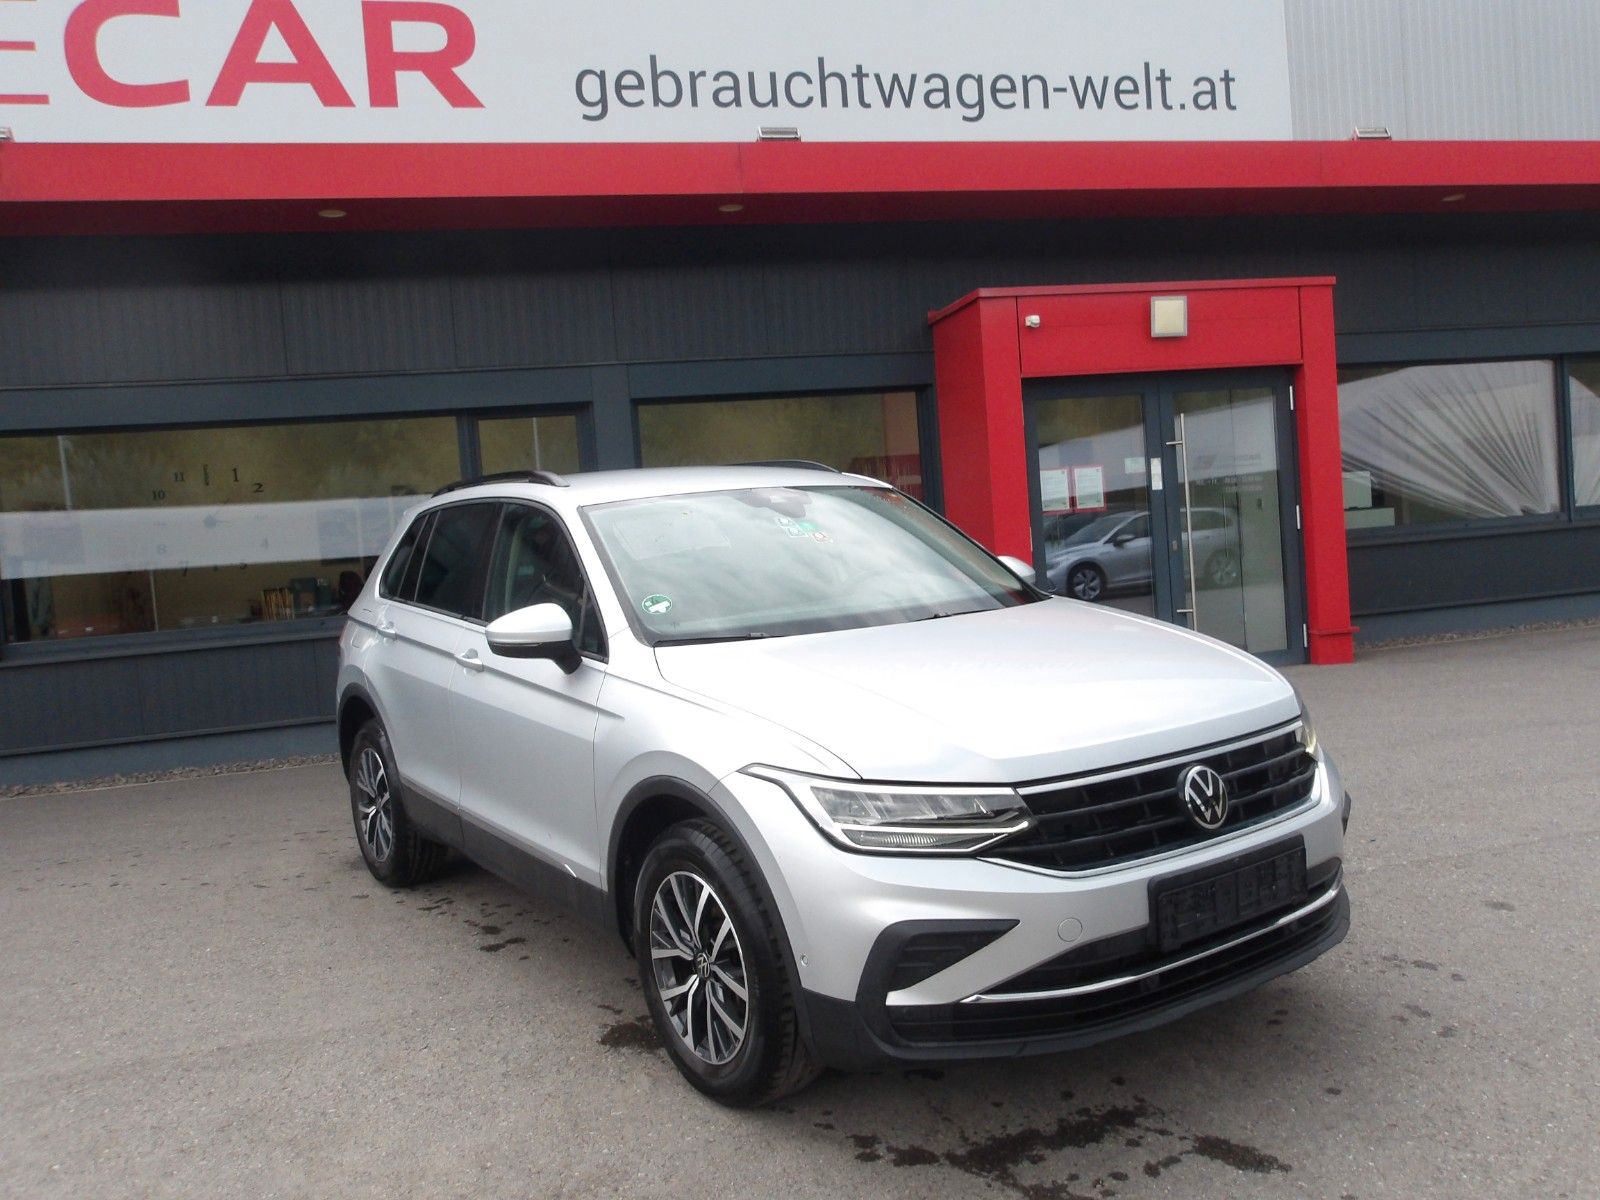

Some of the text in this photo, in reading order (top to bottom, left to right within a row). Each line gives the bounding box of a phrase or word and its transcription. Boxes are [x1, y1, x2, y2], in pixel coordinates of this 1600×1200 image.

[574, 54, 1237, 122] gebrauchtwagen-welt.at
[253, 482, 264, 493] 2
[152, 490, 165, 500] 10
